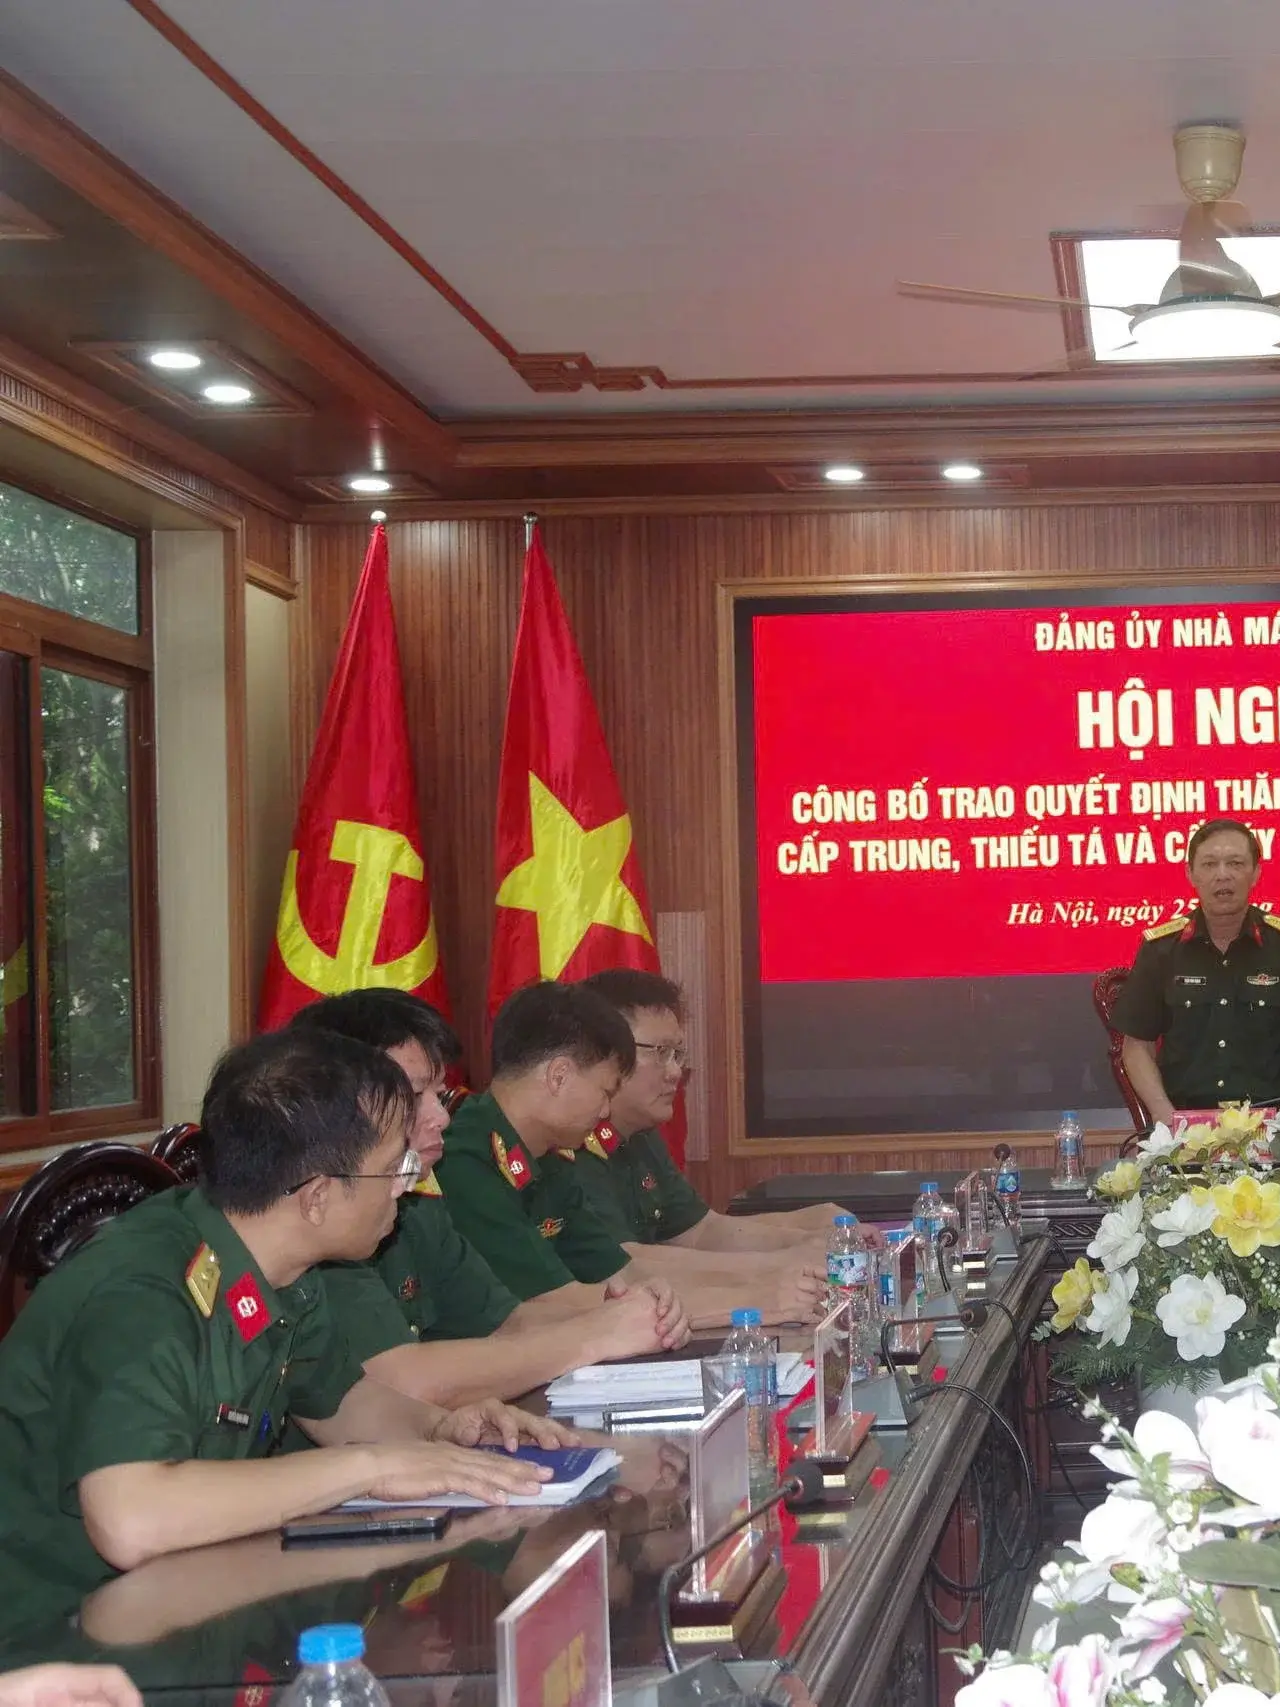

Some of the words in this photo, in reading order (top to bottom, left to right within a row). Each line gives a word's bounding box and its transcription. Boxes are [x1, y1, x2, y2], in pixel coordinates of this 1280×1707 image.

[1035, 613, 1115, 651] ĐẢNG
[1126, 611, 1162, 648] ỦY
[1173, 612, 1232, 647] NHÀ
[1077, 678, 1174, 760] HỘI
[792, 785, 876, 823] CÔNG
[888, 777, 928, 820] BỐ
[938, 786, 1014, 819] TRAO
[1026, 773, 1121, 820] QUYẾT
[1130, 781, 1205, 821] ĐỊNH
[778, 831, 839, 874] CẤP
[849, 838, 960, 873] TRUNG,
[971, 825, 1059, 868] THIẾU
[1068, 827, 1107, 865] TÁ
[1115, 825, 1156, 864] VÀ
[1008, 903, 1043, 924] Hà
[1051, 900, 1098, 927] Nội,
[1107, 900, 1164, 926] ngày
